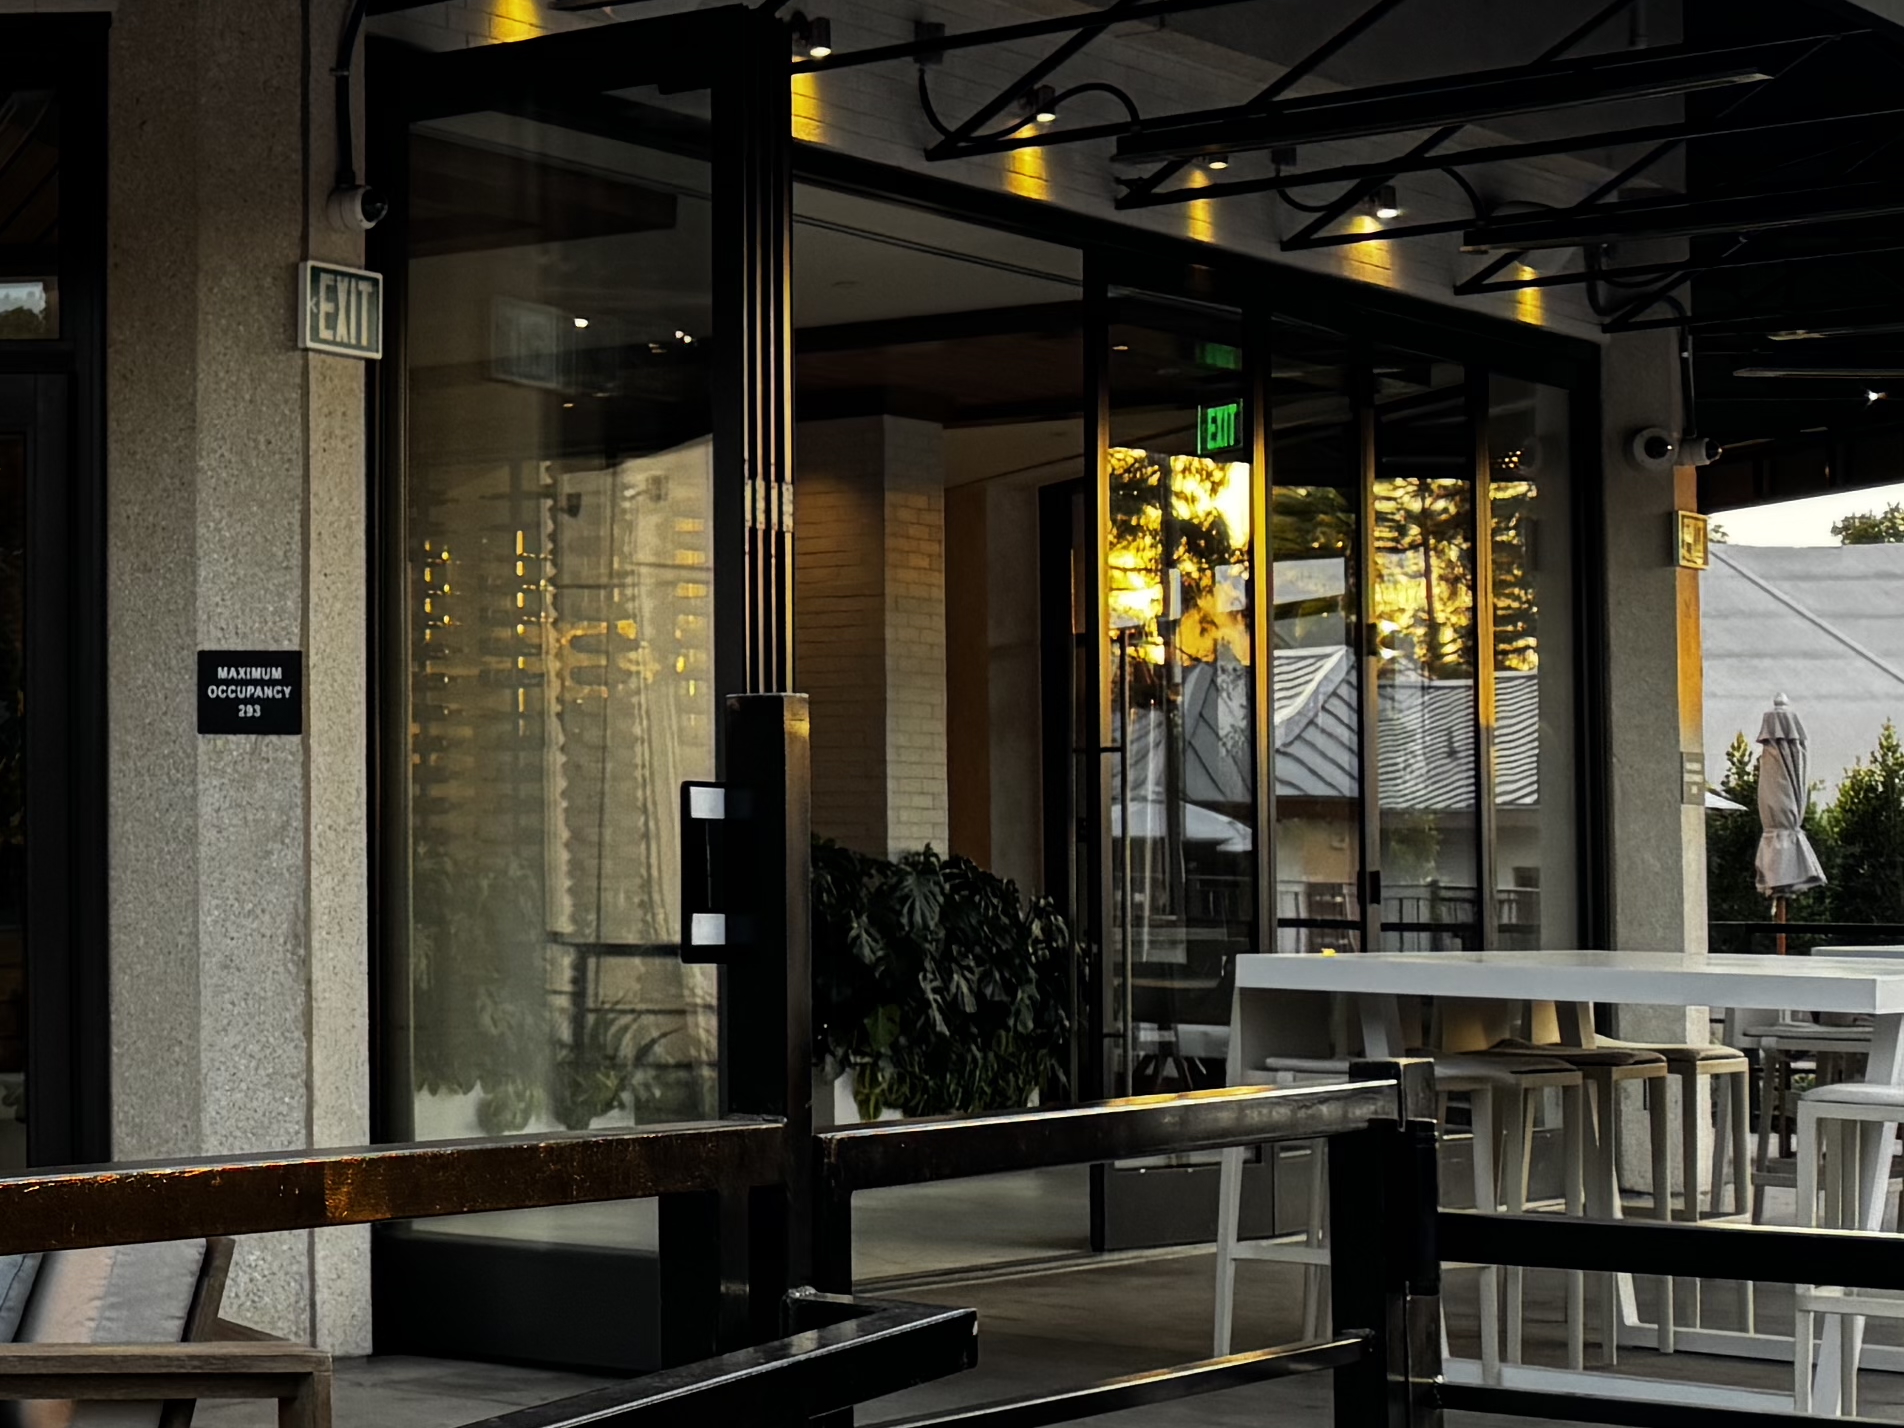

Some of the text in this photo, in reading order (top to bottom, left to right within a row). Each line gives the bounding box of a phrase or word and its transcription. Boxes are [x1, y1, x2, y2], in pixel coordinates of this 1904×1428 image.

[318, 272, 373, 347] EXIT
[1207, 403, 1237, 450] EXIT
[217, 666, 283, 681] MAXIMUM
[207, 684, 292, 699] OCCUPANCY
[237, 704, 262, 718] 293
